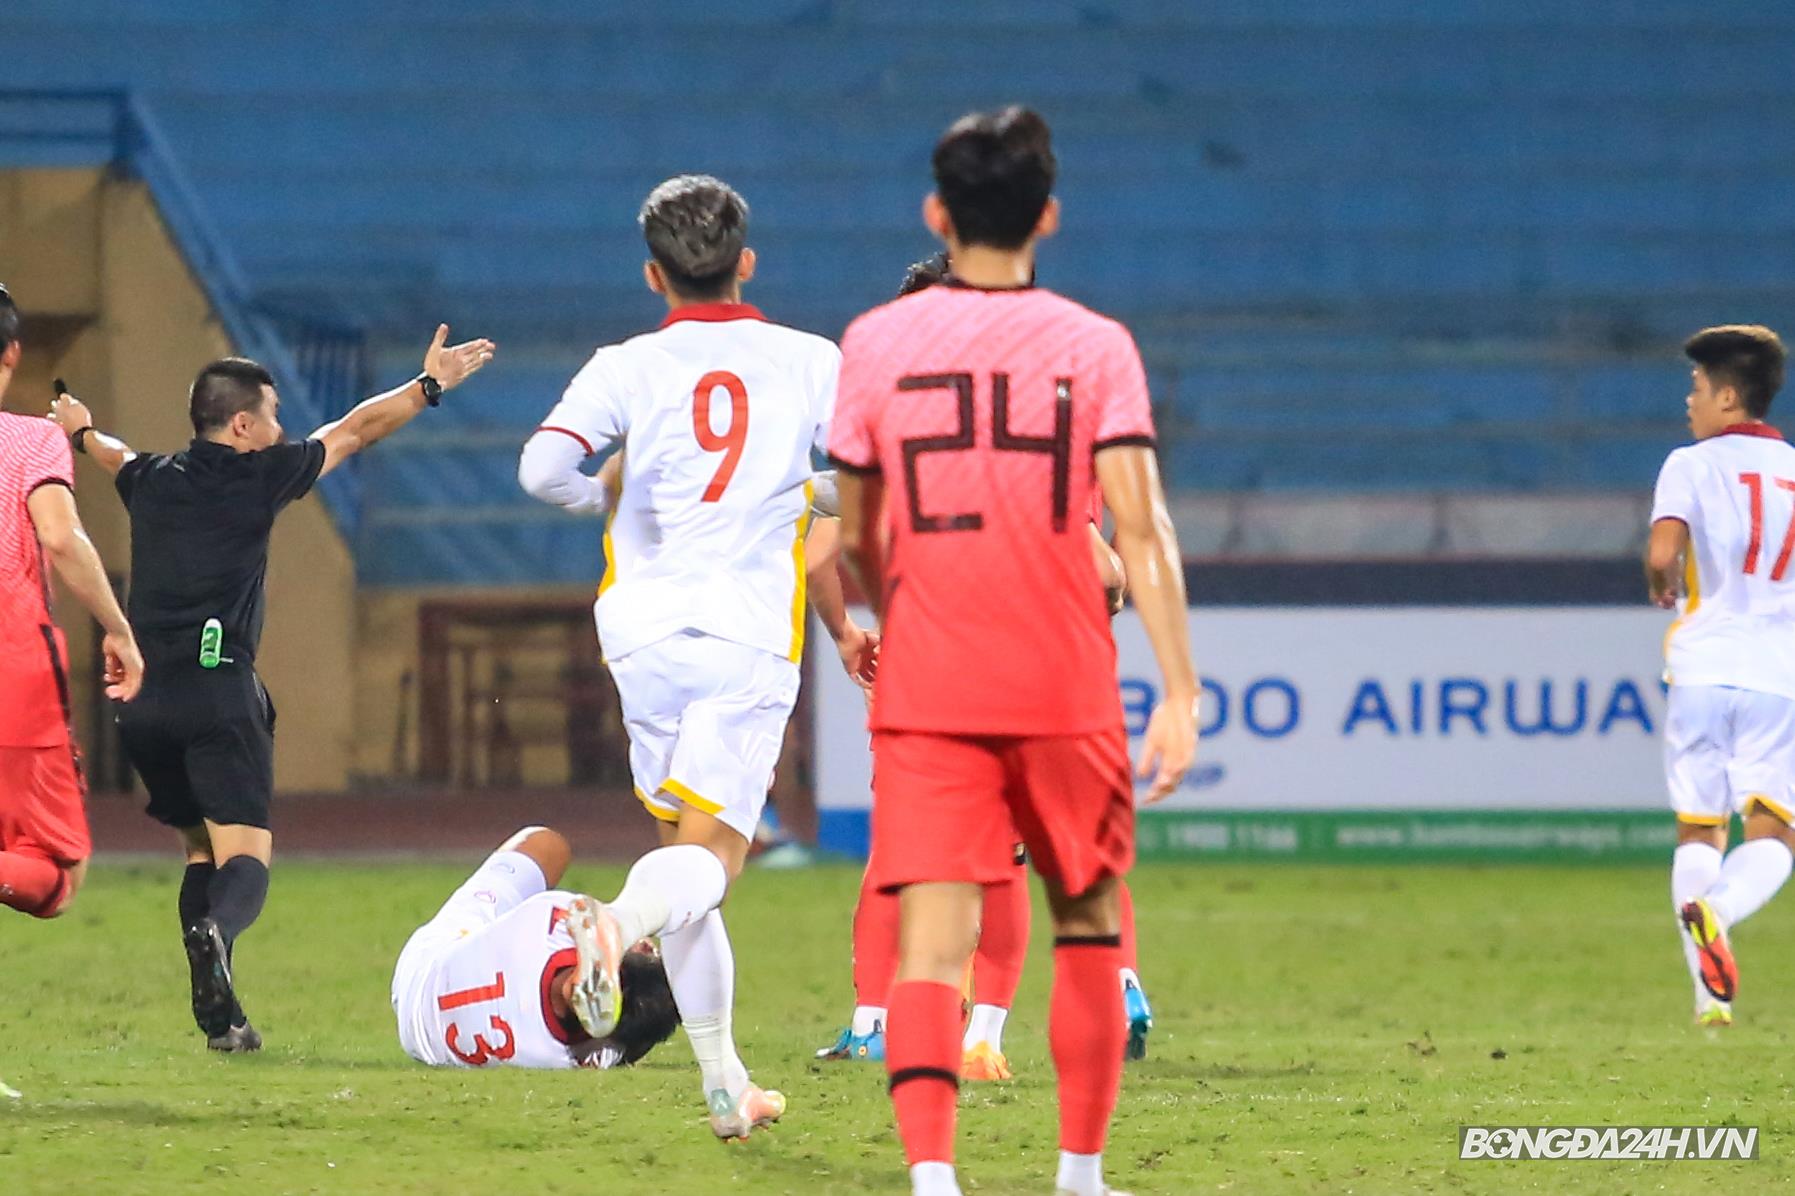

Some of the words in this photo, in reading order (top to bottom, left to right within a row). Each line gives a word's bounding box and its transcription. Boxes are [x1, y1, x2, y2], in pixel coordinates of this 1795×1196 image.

[693, 370, 748, 502] 9
[897, 371, 1072, 533] 24
[1739, 472, 1795, 582] 17
[1342, 679, 1668, 736] AIRWA
[437, 971, 515, 1066] 13
